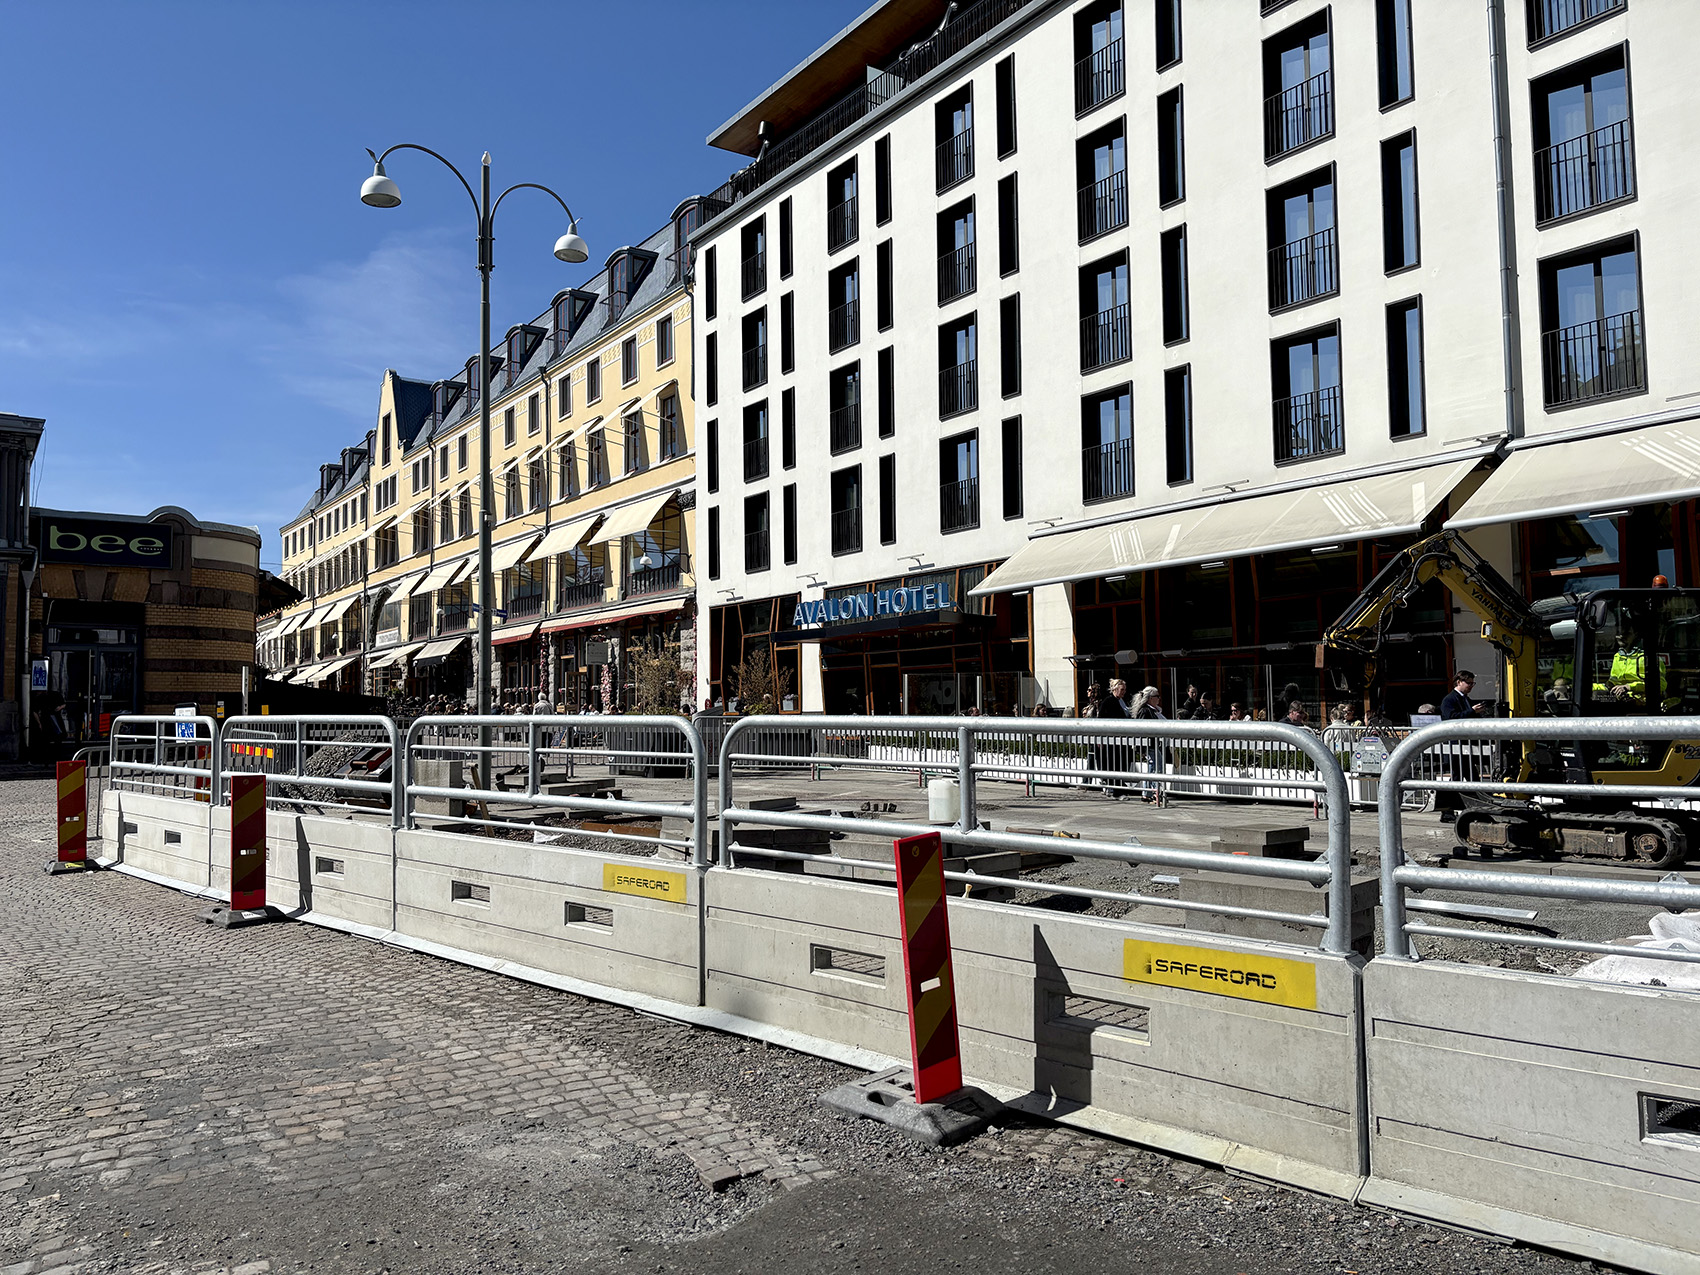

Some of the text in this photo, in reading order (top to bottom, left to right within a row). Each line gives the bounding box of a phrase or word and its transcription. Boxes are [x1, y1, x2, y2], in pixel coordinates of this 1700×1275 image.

[49, 525, 164, 556] bee
[792, 582, 950, 626] AVALON HOTEL
[616, 875, 670, 892] SAFEROAD
[1155, 958, 1277, 990] SAFEROAD
